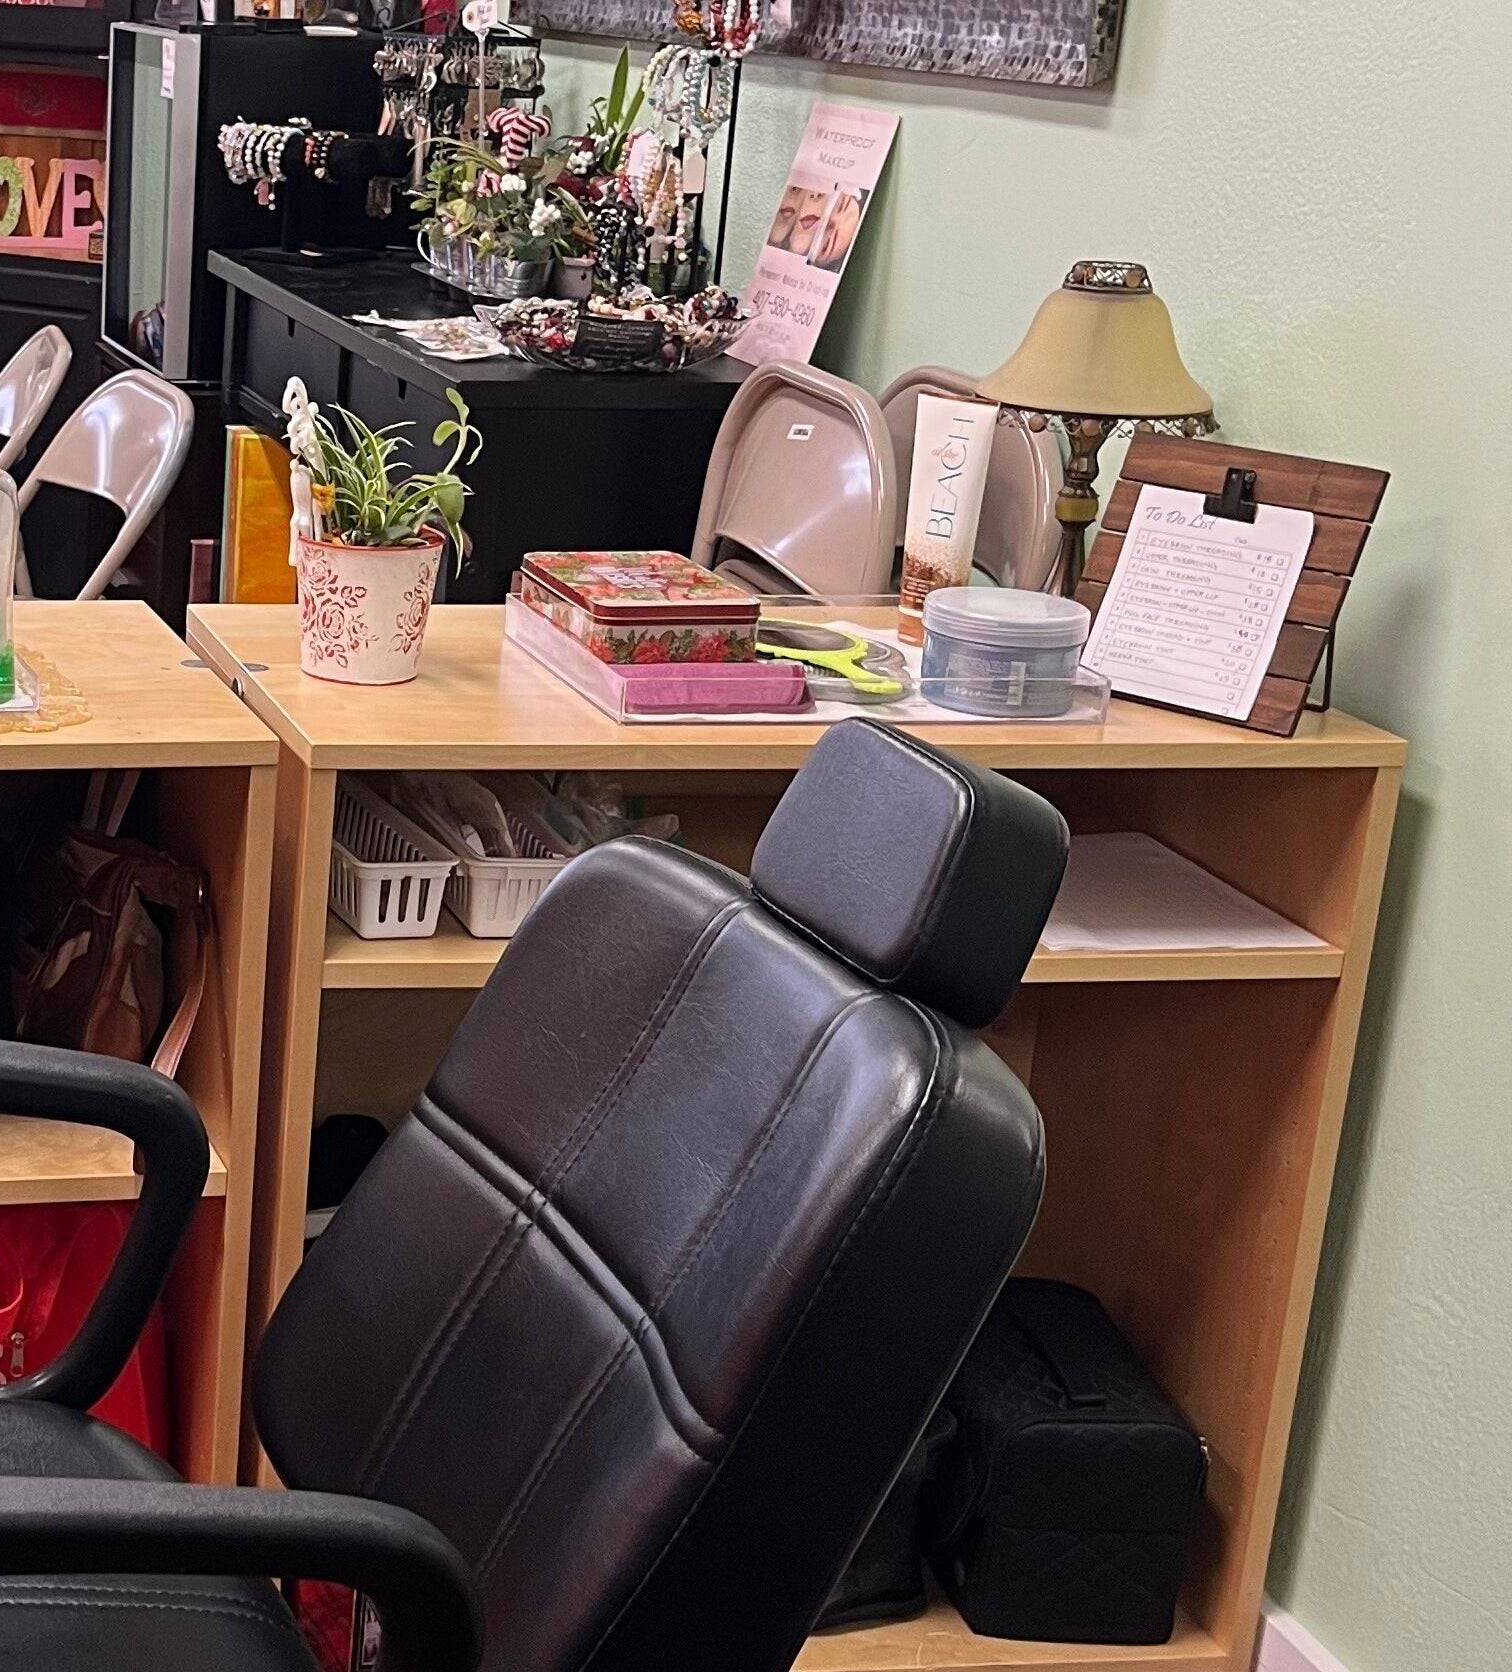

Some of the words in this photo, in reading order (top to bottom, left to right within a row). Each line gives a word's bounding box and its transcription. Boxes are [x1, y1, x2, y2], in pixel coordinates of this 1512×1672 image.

[816, 127, 876, 149] WATERPROOF
[818, 152, 856, 169] MAKEUP
[925, 417, 975, 539] BEACH
[1145, 506, 1162, 521] To
[1166, 510, 1186, 525] Do
[1187, 514, 1218, 531] List
